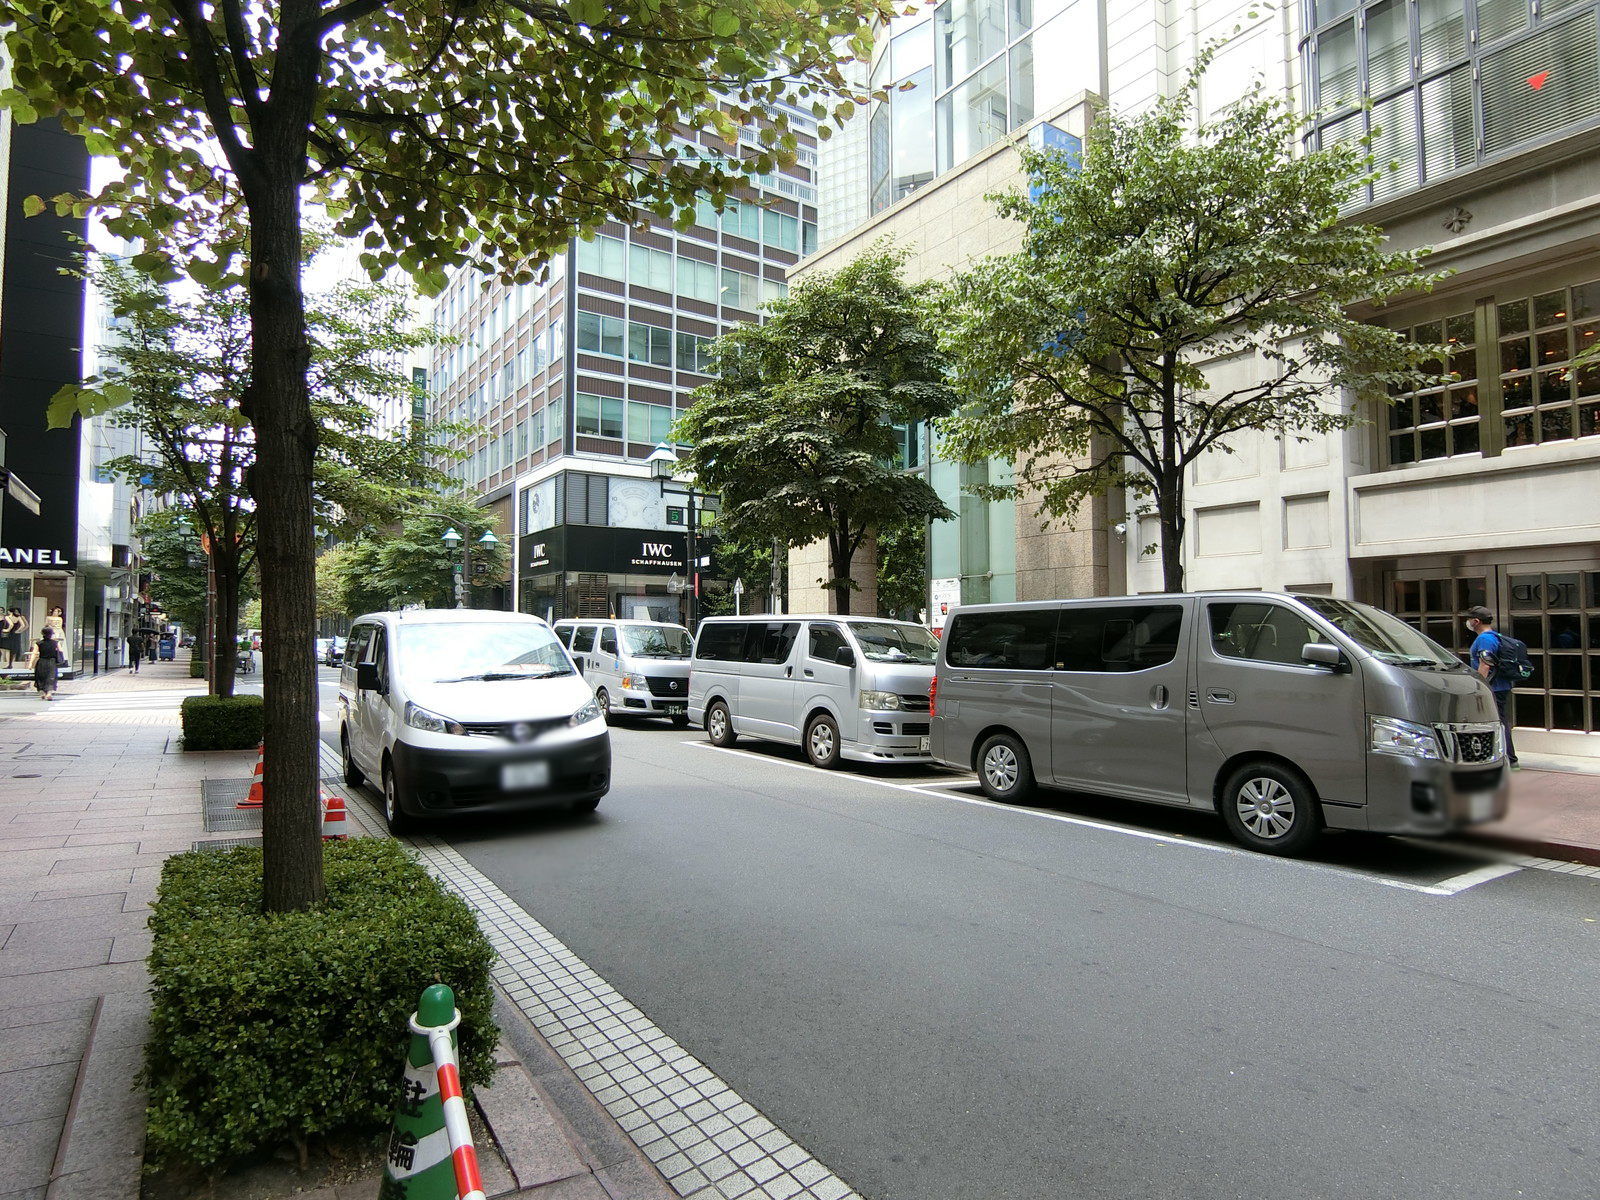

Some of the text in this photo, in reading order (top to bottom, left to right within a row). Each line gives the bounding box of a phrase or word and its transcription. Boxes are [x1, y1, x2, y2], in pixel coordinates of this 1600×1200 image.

[671, 511, 679, 521] 5
[0, 547, 69, 565] ANEL
[533, 543, 546, 559] IWC
[642, 542, 672, 558] IWC
[631, 559, 682, 567] SCHAFFHAUSEN
